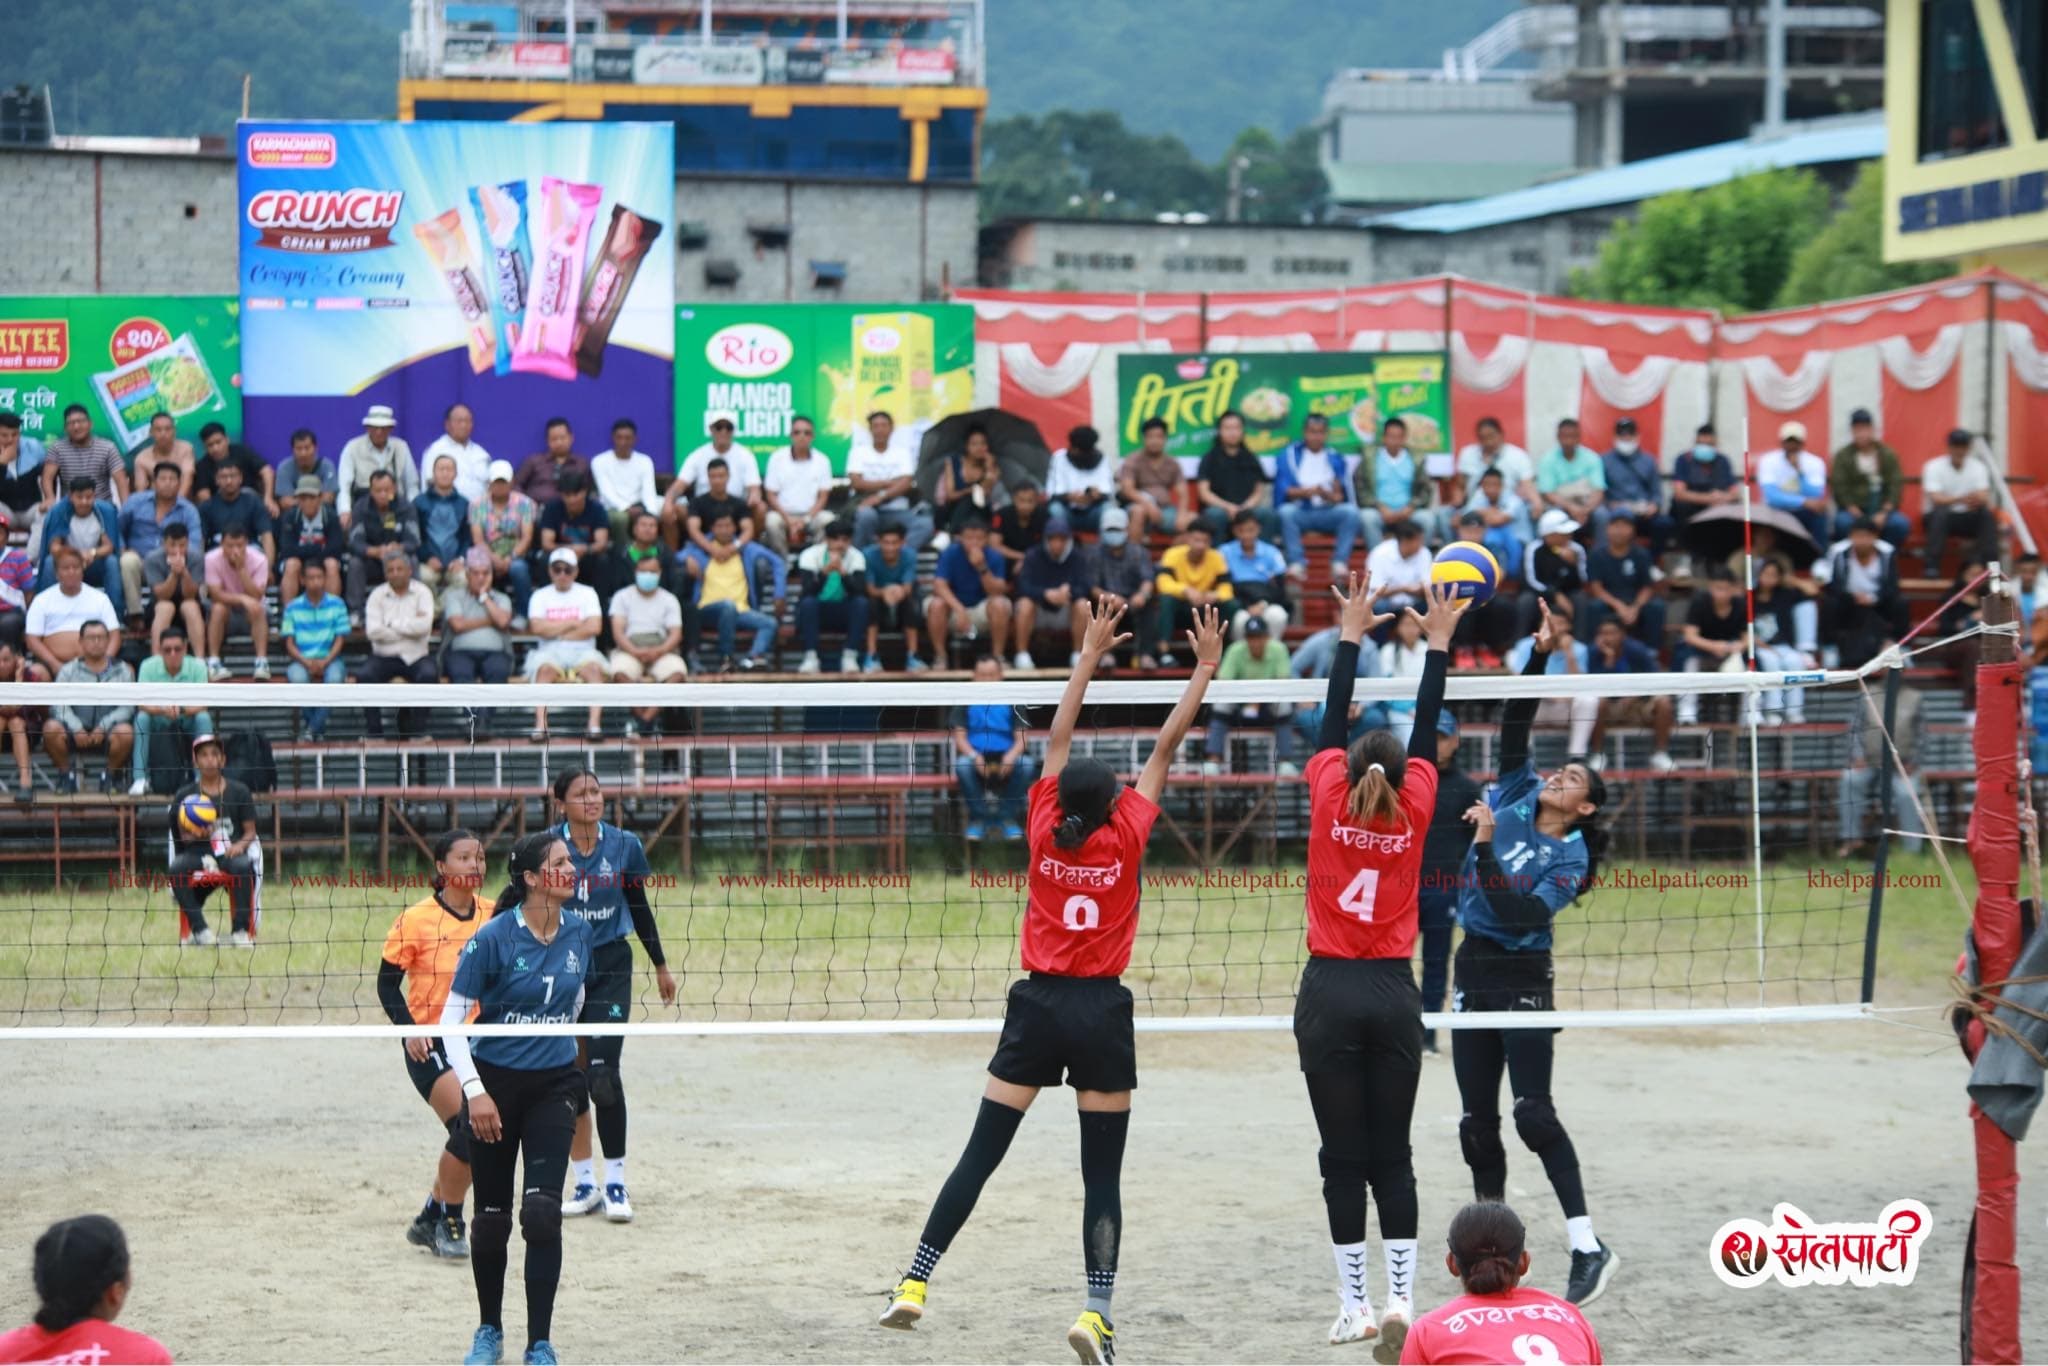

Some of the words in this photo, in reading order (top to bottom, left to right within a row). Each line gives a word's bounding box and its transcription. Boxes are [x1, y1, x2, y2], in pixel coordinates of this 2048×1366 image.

[248, 189, 402, 230] CRUNCH
[281, 236, 325, 250] CREAM
[329, 236, 371, 250] WAFER
[249, 264, 308, 287] Crispy
[338, 265, 405, 289] Creamy
[721, 336, 778, 365] Rio
[708, 383, 791, 410] MANGO
[1338, 868, 1379, 922] 4
[542, 976, 555, 1005] 7
[1442, 1302, 1576, 1333] everest
